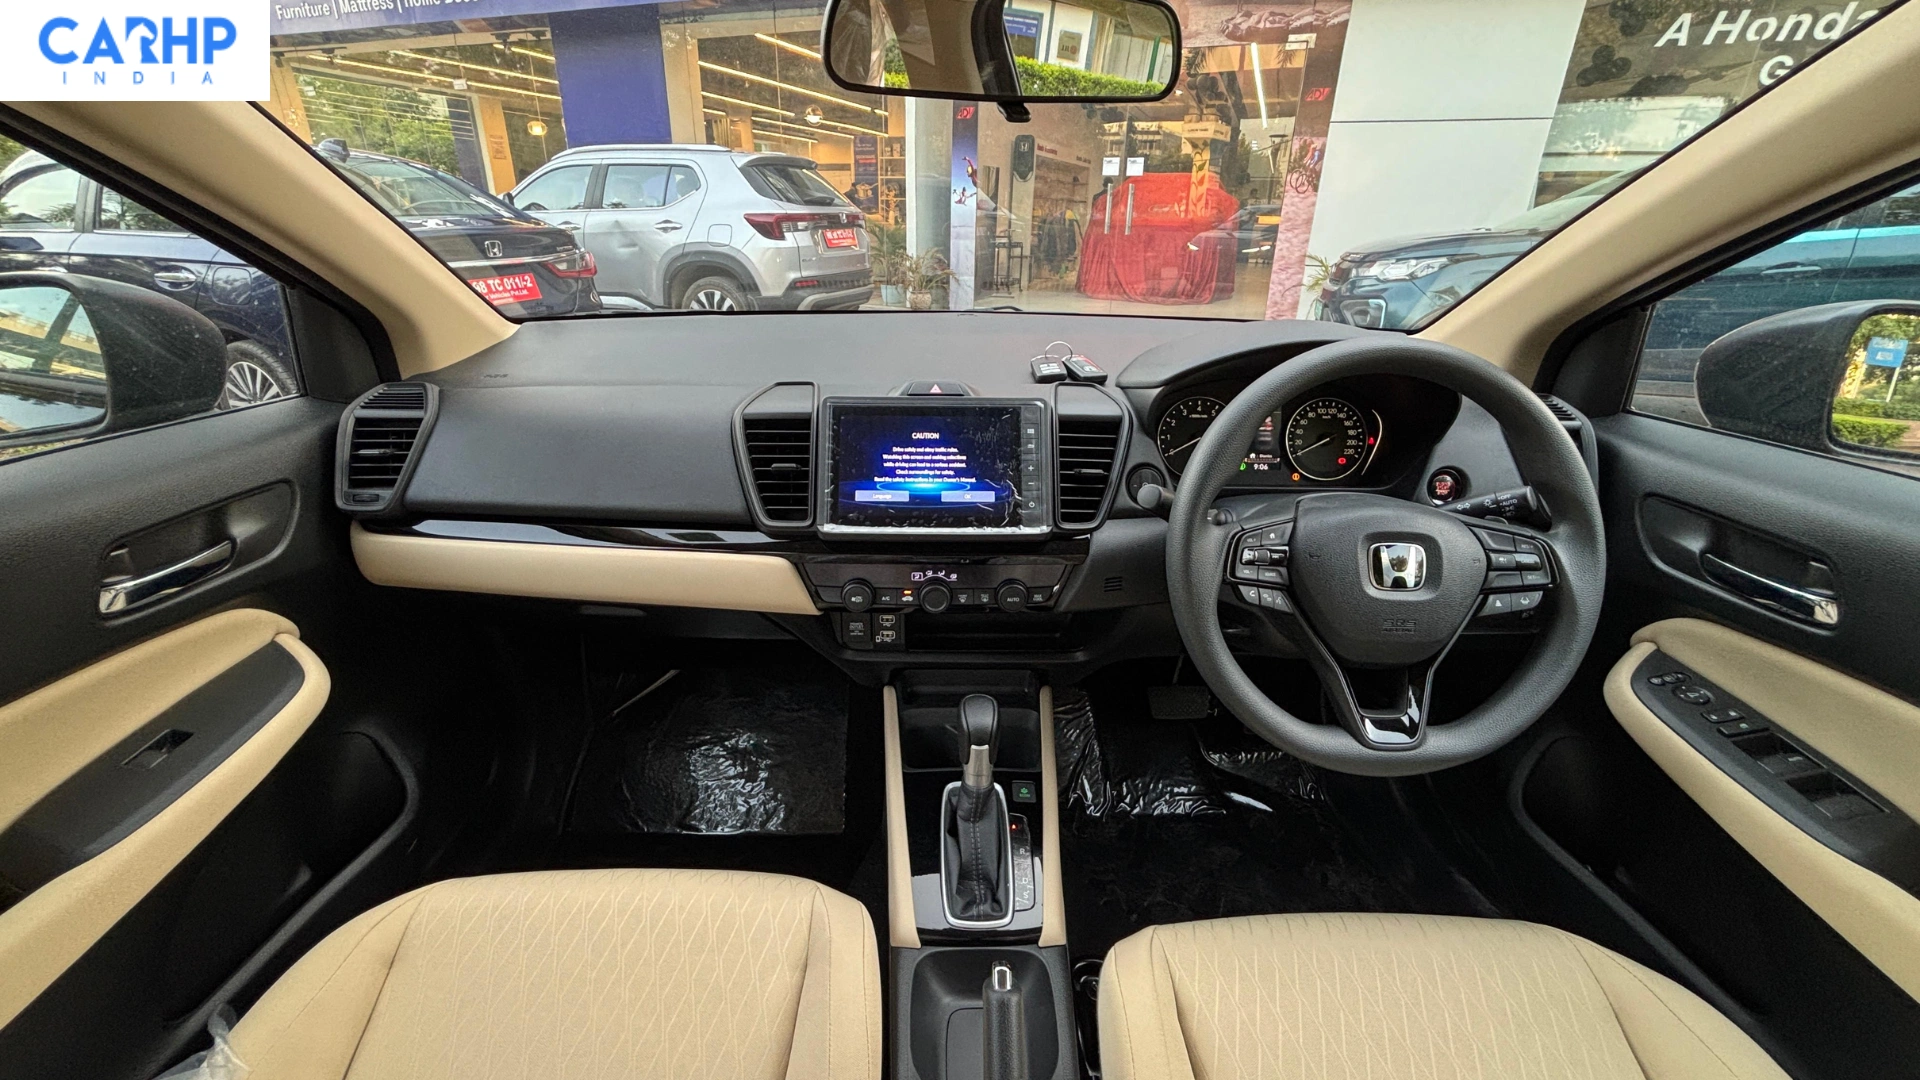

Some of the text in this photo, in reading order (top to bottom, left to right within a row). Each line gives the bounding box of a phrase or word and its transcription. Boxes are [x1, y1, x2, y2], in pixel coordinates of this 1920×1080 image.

[275, 2, 331, 20] Furniture
[340, 0, 394, 14] Mattress
[1653, 12, 1693, 48] A
[487, 279, 504, 292] TC
[1211, 409, 1216, 417] 5
[1171, 419, 1176, 427] 2
[912, 432, 939, 440] CAUTION
[1253, 463, 1269, 471] 9:06
